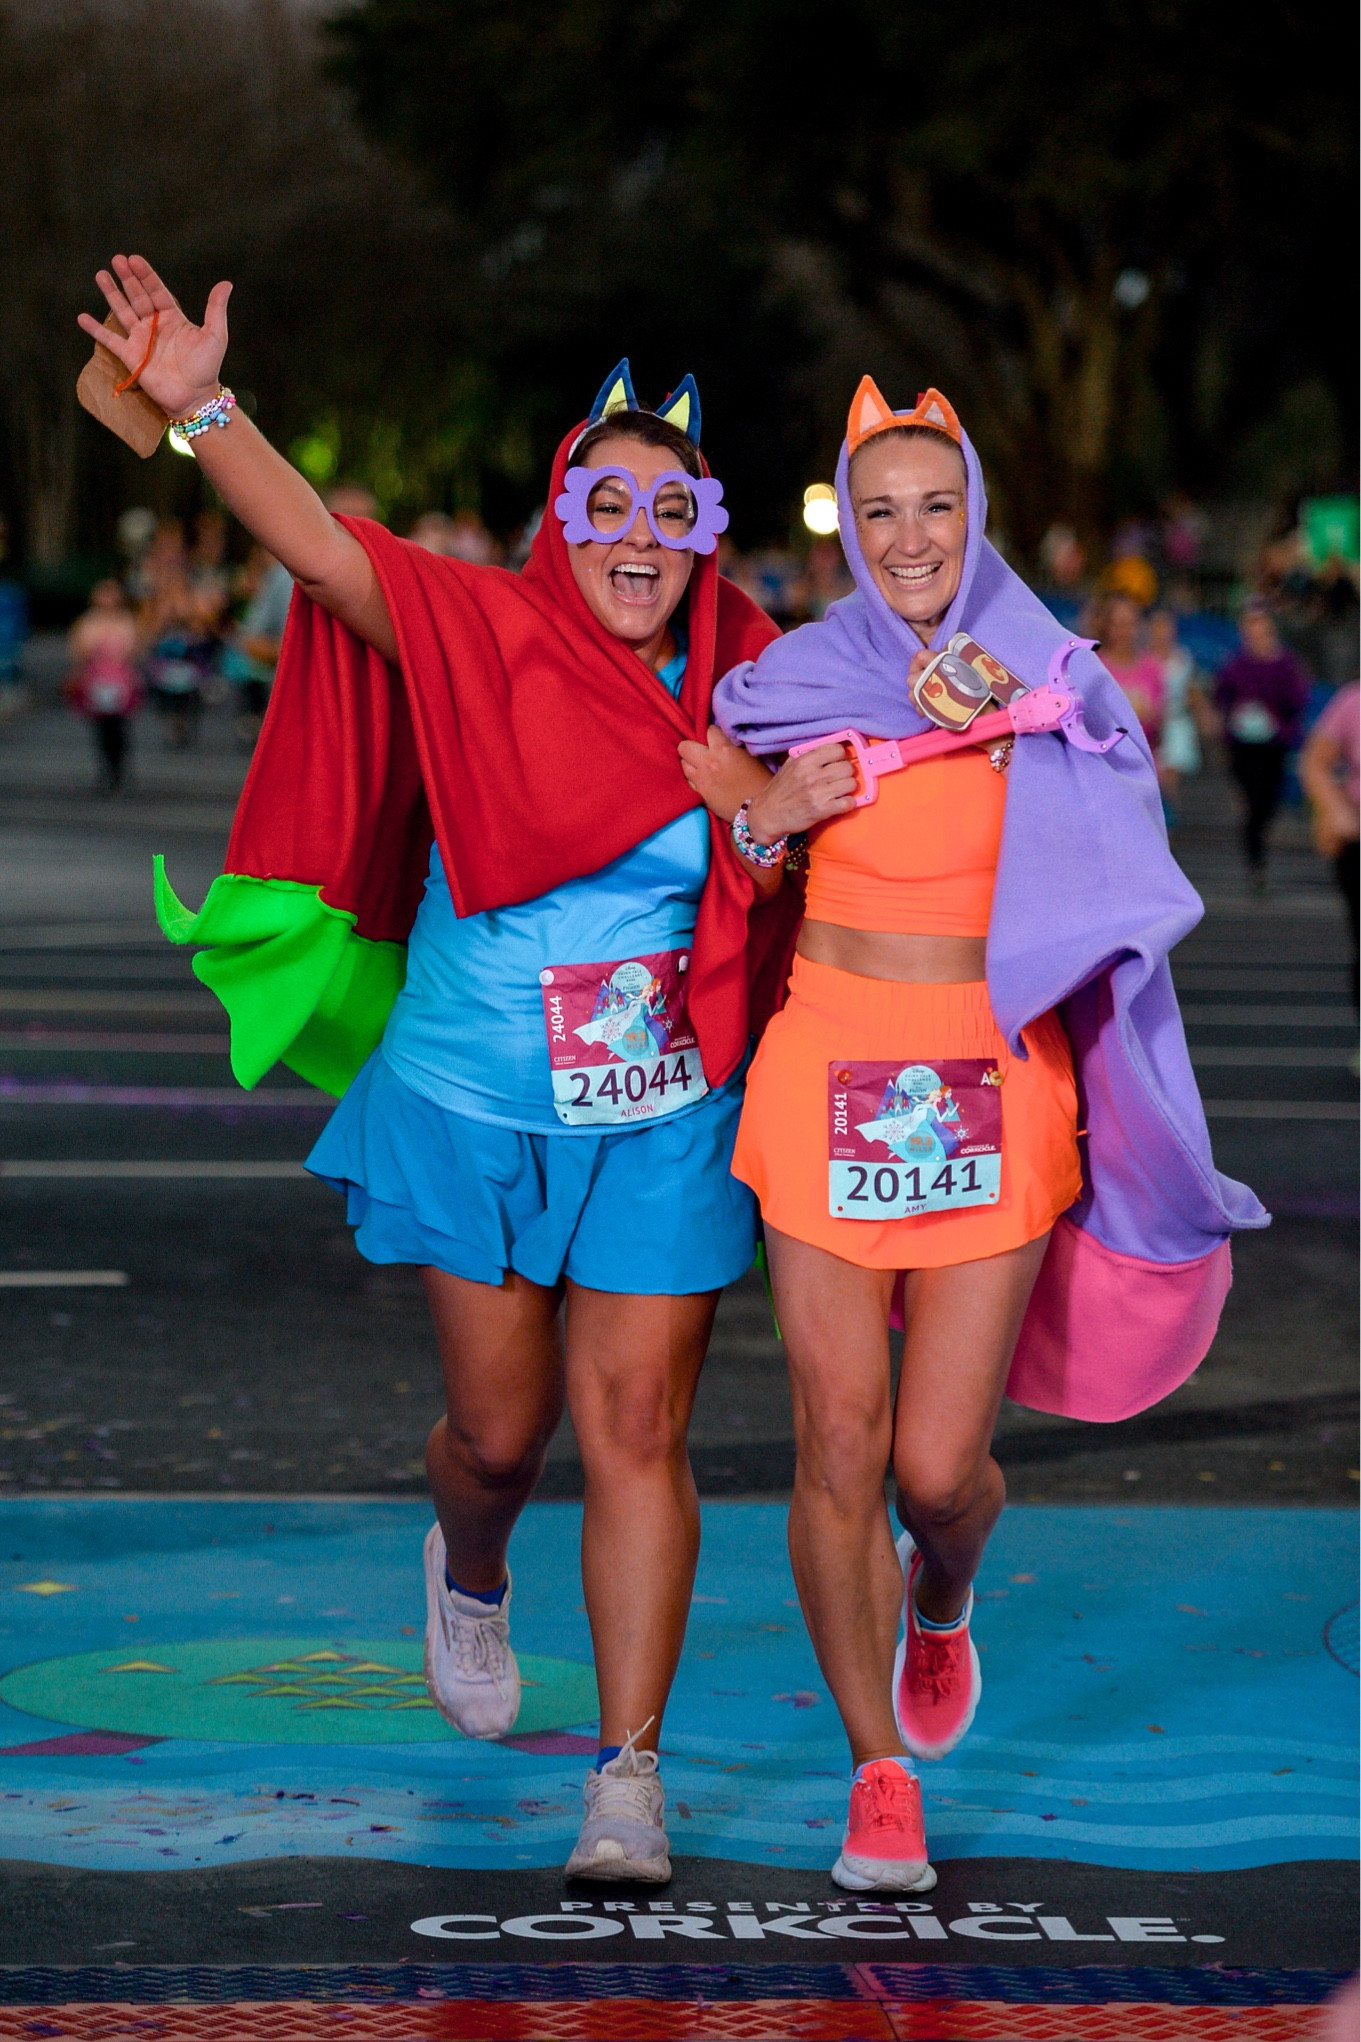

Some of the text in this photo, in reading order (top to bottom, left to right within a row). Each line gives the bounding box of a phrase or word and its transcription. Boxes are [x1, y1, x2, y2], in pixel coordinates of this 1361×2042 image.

[549, 995, 566, 1043] 24044
[553, 1055, 576, 1063] CITIZEN
[569, 1055, 692, 1107] 24044
[620, 1104, 654, 1117] ALISON
[834, 1092, 848, 1136] 20141
[847, 1160, 983, 1203] 20141
[904, 1203, 927, 1214] AMY
[966, 1902, 1046, 1913] BY
